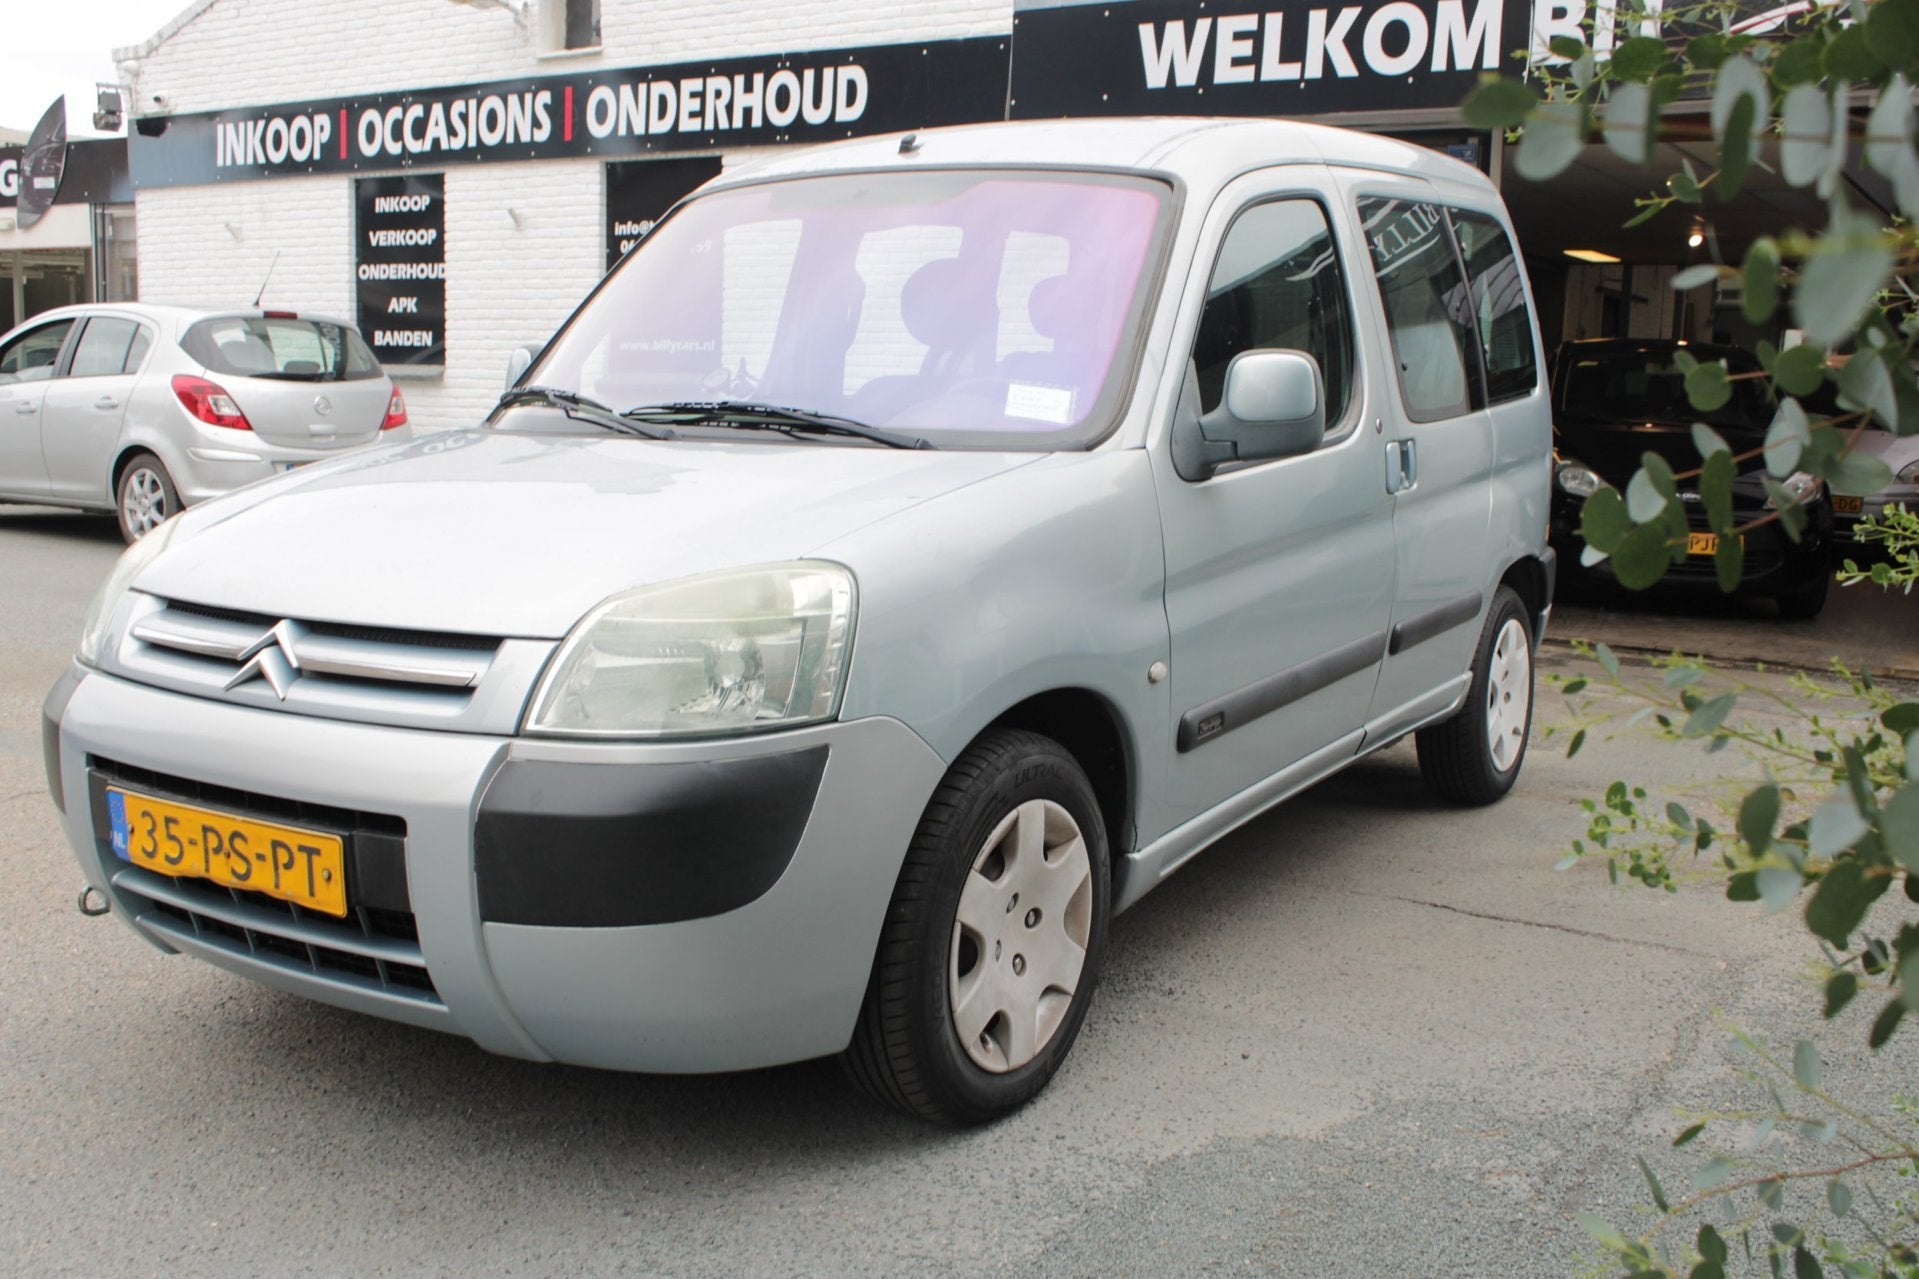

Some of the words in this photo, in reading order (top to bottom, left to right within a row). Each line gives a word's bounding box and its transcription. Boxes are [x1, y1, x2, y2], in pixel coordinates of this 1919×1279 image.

[1138, 0, 1505, 90] WELKOM
[216, 113, 332, 167] INKOOP
[357, 90, 553, 158] OCCASIONS
[586, 64, 869, 140] ONDERHOUD
[374, 194, 431, 214] INKOOP
[368, 228, 437, 247] VERKOOP
[358, 262, 445, 281] ONDERHOUD
[387, 296, 418, 314] APK
[373, 329, 433, 347] BANDEN
[112, 830, 127, 850] NL
[140, 809, 322, 899] 35-PS-PT
